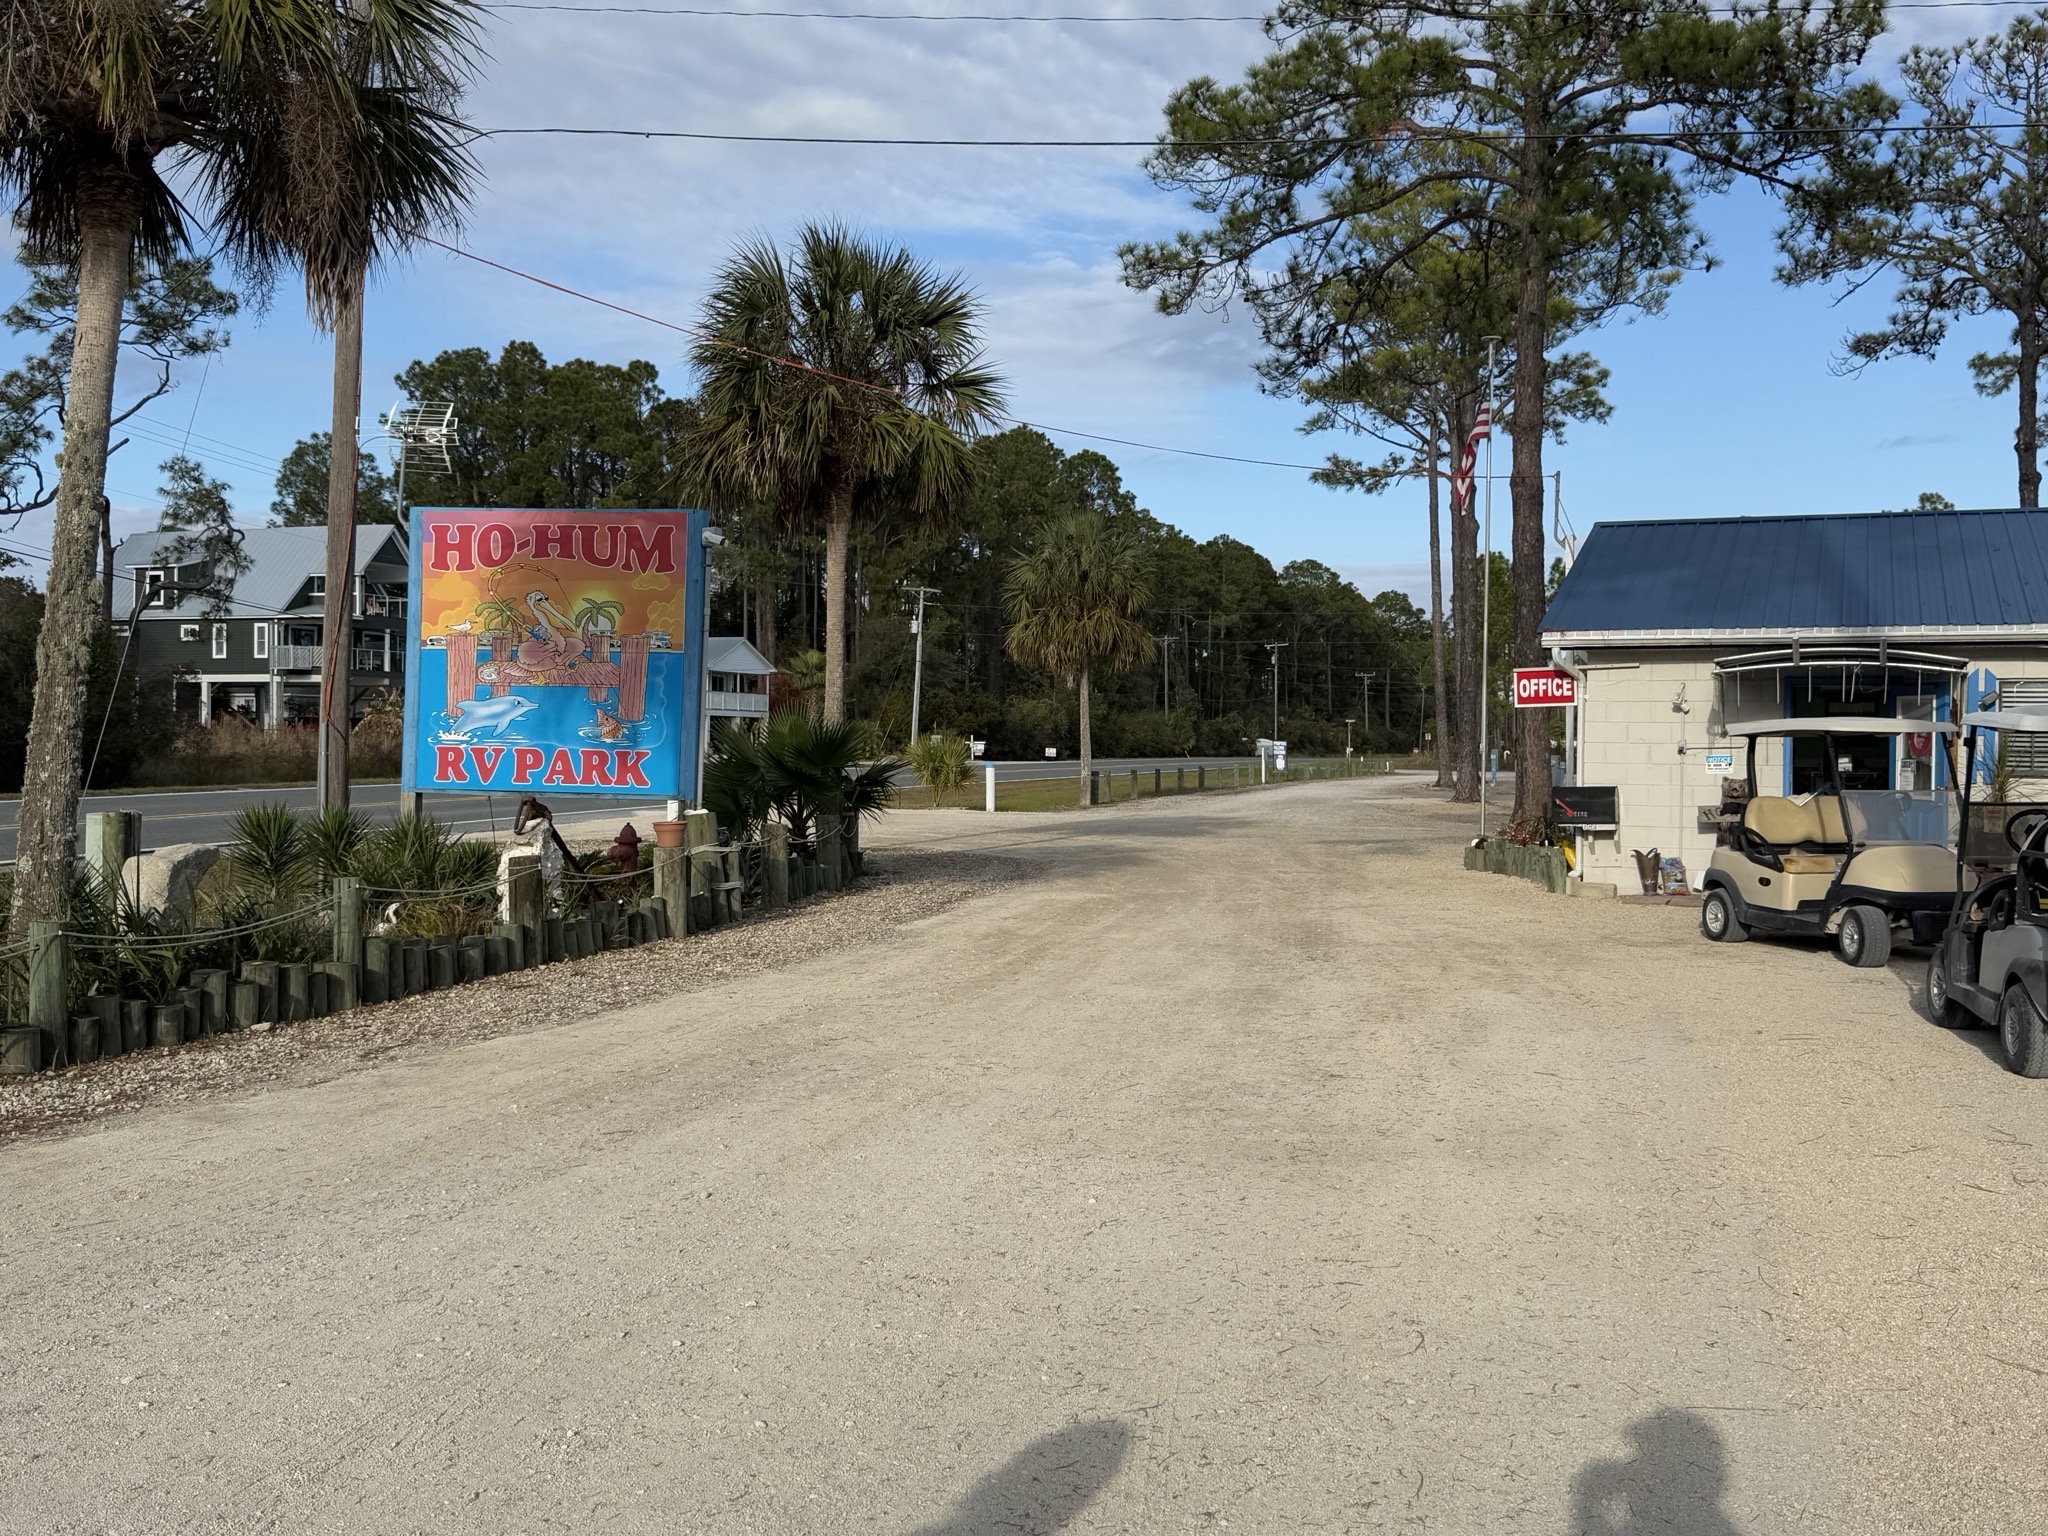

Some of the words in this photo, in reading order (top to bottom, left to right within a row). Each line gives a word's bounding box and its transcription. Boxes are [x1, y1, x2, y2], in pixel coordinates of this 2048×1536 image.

[430, 523, 676, 574] HO-HUM
[1519, 677, 1573, 698] OFFICE
[434, 745, 506, 785] RV
[512, 747, 651, 788] PARK
